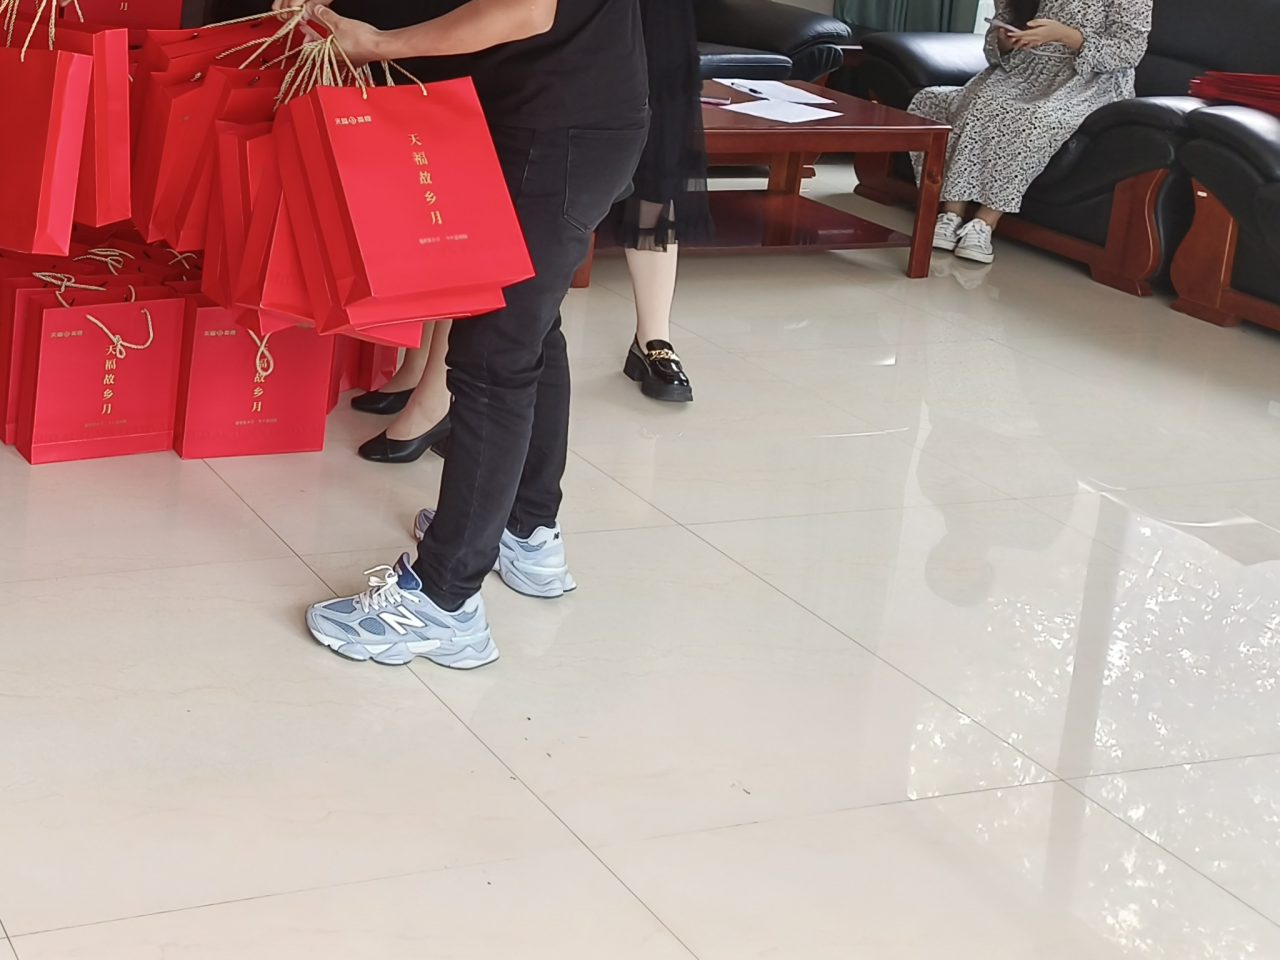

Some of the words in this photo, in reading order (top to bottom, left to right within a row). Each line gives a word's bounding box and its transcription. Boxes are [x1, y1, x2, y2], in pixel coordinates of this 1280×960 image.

[408, 133, 443, 225] 天福故乡月
[101, 344, 117, 414] 天福故乡月
